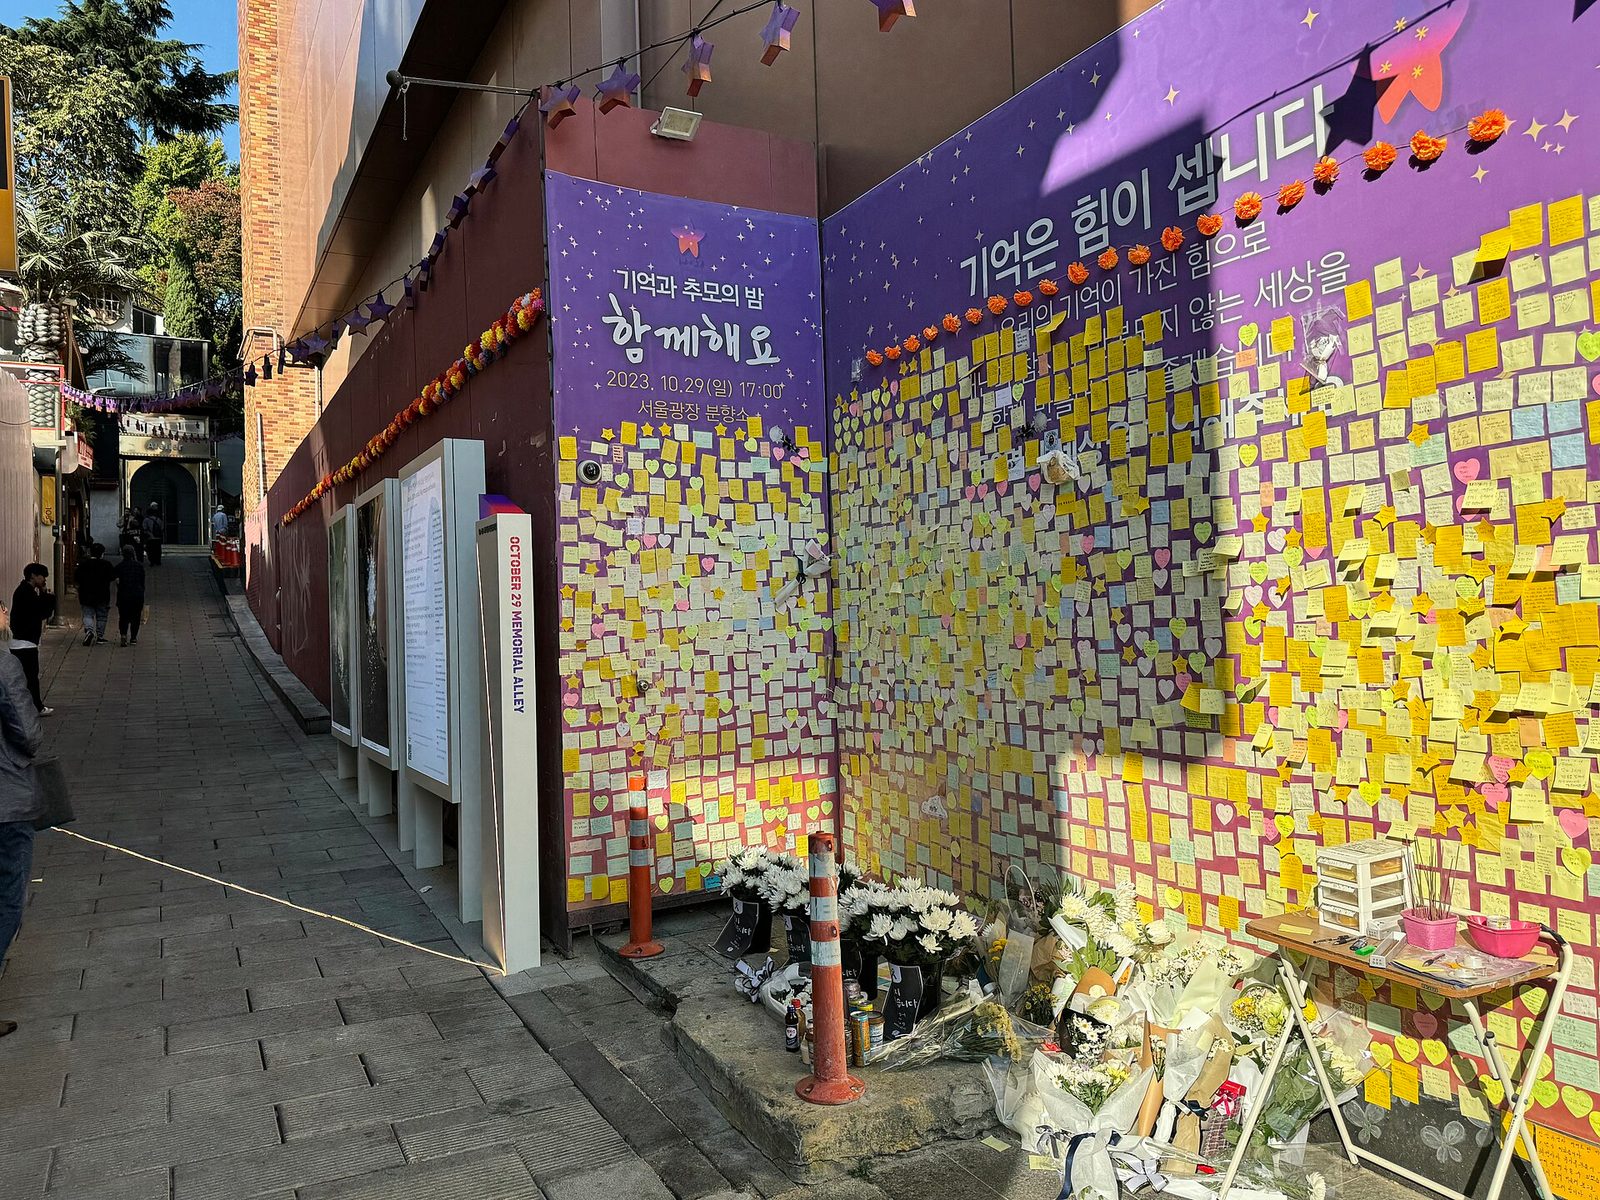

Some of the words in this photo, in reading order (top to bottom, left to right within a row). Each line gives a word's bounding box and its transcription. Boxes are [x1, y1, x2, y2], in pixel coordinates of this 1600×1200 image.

[960, 217, 1060, 299] 기억은
[1071, 167, 1151, 258] 힘이
[1167, 83, 1335, 216] 셉니다
[616, 269, 677, 299] 기억과
[682, 278, 740, 307] 추모의
[745, 287, 765, 310] 밤
[1060, 274, 1122, 320] 기억이
[1128, 253, 1178, 295] 가진
[1185, 221, 1271, 280] 힘으로
[1189, 289, 1245, 334] 않는
[1254, 251, 1351, 309] 세상을
[601, 293, 781, 366] 함께해요
[606, 370, 654, 391] 2023.
[660, 375, 733, 398] 10.29(일)
[739, 381, 783, 400] 17:00
[638, 400, 700, 421] 서울광장
[705, 405, 749, 423] 분향소
[510, 536, 521, 591] OCTOBER
[511, 593, 522, 608] 29
[511, 611, 523, 674] MEMORIAL
[513, 676, 525, 714] ALLEY
